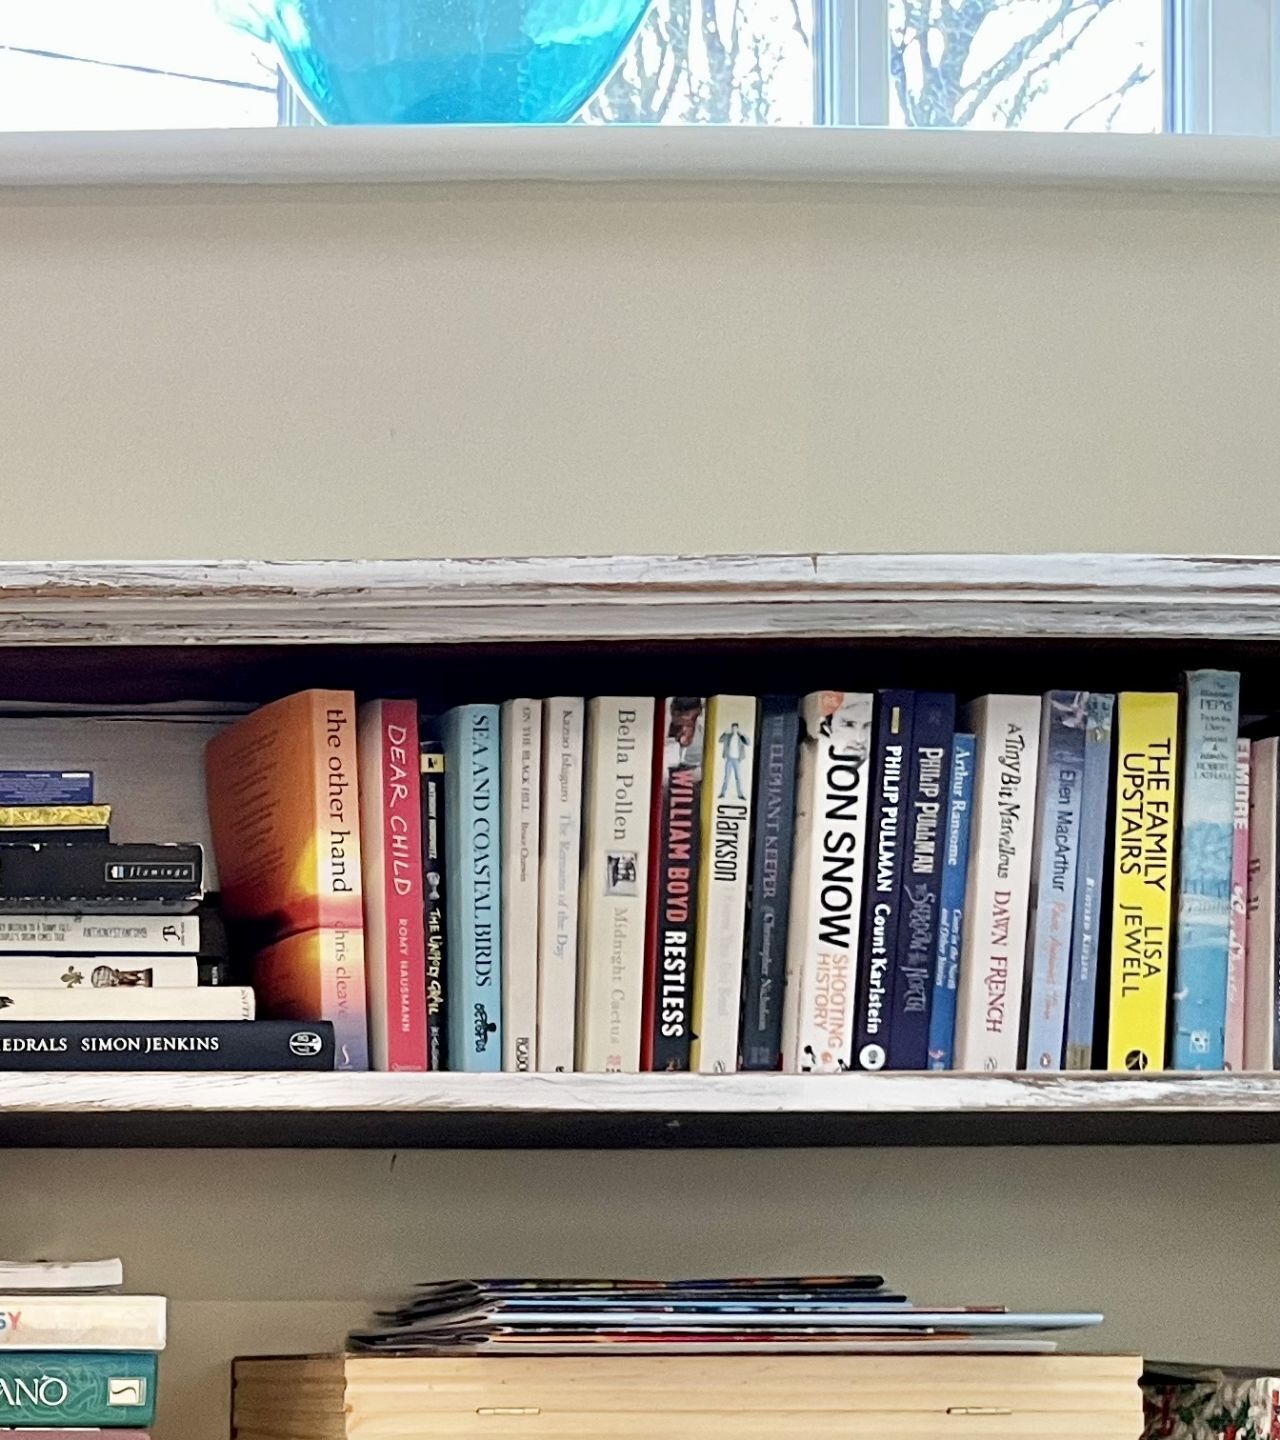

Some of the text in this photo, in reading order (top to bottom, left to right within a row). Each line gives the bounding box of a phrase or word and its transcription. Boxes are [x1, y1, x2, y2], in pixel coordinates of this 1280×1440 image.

[327, 709, 353, 893] the other hand
[558, 709, 572, 803] Kazuo Ishiguro
[614, 708, 637, 841] Bella Pollen
[917, 747, 943, 798] PHILIP
[947, 746, 971, 866] Arthur Ransome
[1120, 753, 1145, 876] UPSTAIRS
[1143, 737, 1171, 892] THE FAMILY
[387, 724, 412, 1033] DEAR CHILD ROMY HAUSMANN
[472, 714, 492, 987] SEA AND COASTAL BIRDS
[713, 804, 748, 883] Clarkson
[762, 743, 784, 898] ELEPHANT KEEPER
[818, 745, 861, 949] JON SNOW
[912, 801, 940, 874] PULLMAN
[984, 723, 1026, 1033] A Tiny Bit Marvellous DAWN FRENCH
[1052, 769, 1076, 892] Ellen MacArthur
[334, 921, 350, 962] chris
[428, 908, 442, 935] THE
[610, 907, 628, 982] Midnight
[661, 770, 695, 1037] WILLIAM BOYD RESTLESS
[867, 745, 903, 1034] PHILIP PULLMAN Count Karlstein
[814, 952, 831, 1032] HISTORY
[827, 954, 849, 1048] SHOOTING
[1119, 903, 1143, 998] JEWELL
[1142, 926, 1163, 979] LISA
[81, 1037, 140, 1052] SIMON
[145, 1037, 220, 1053] JENKINS
